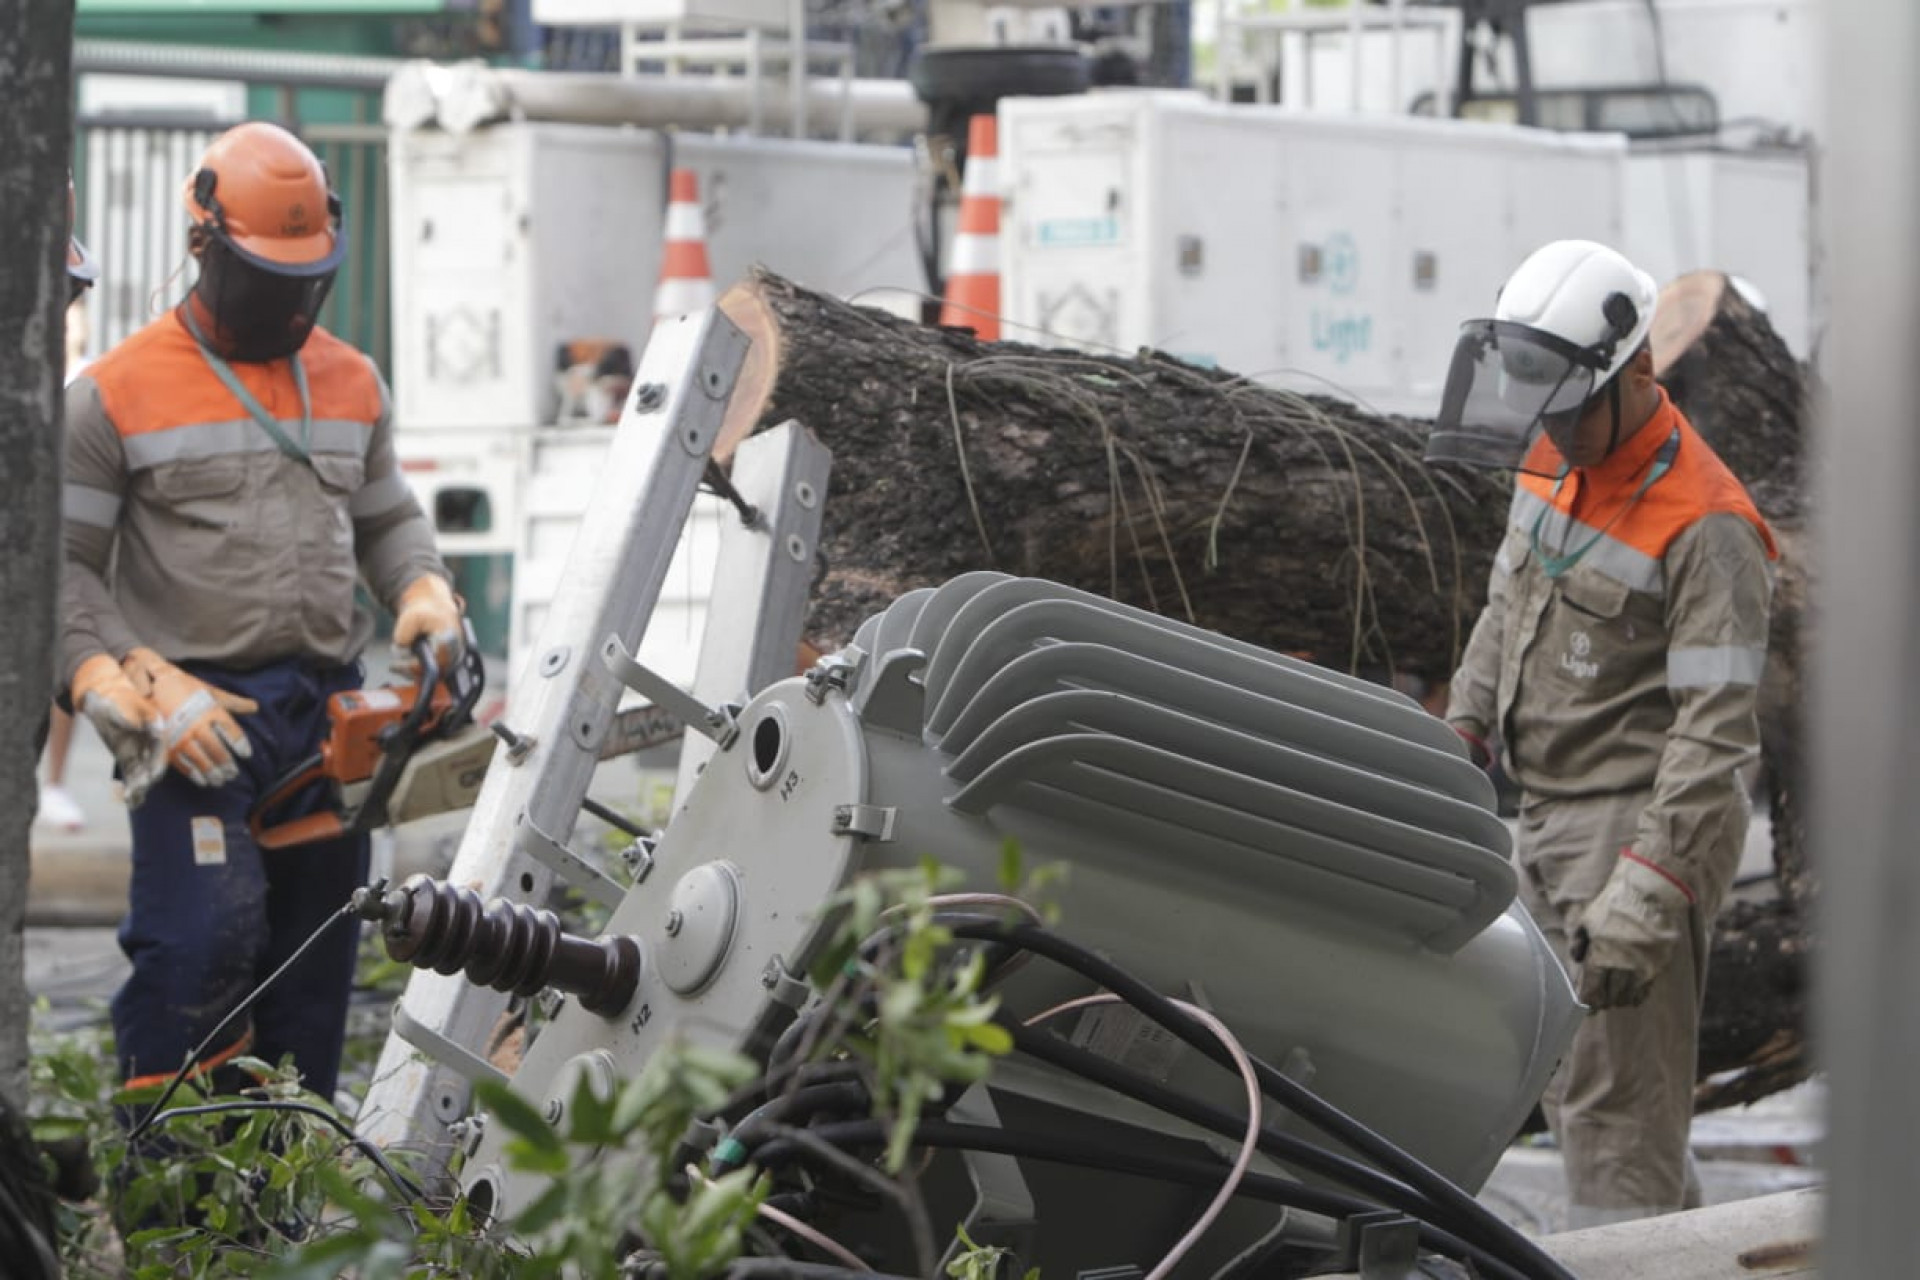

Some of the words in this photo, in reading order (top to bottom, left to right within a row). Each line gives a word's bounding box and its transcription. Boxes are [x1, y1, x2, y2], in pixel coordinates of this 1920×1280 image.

[1310, 306, 1371, 363] Light
[1561, 652, 1598, 678] Light
[780, 769, 798, 801] H3
[631, 1003, 652, 1035] H2
